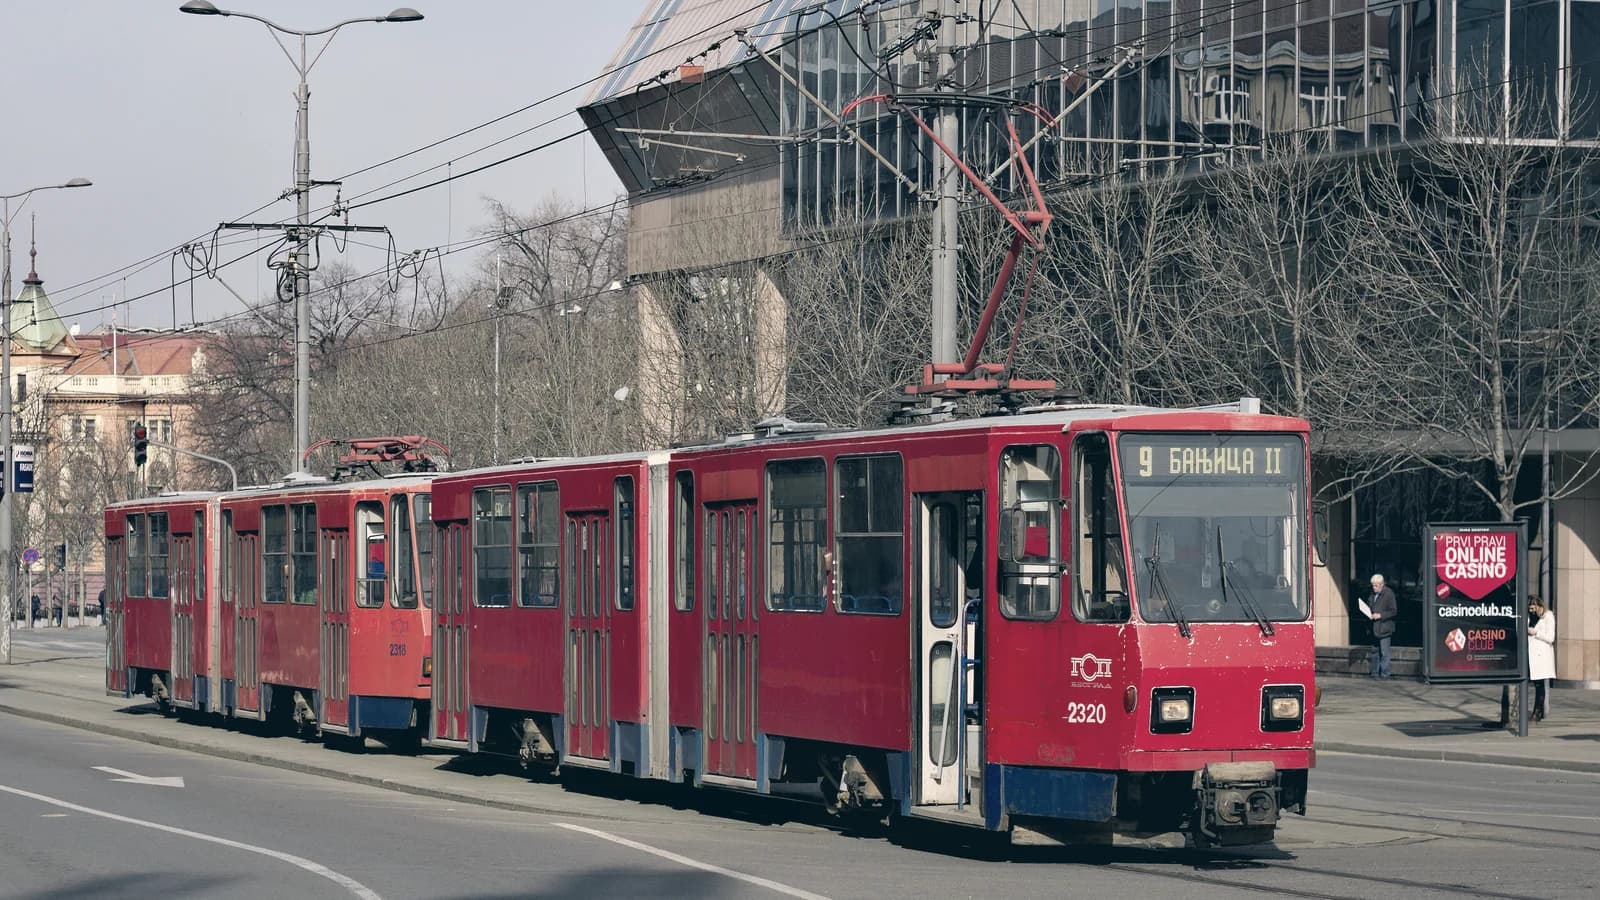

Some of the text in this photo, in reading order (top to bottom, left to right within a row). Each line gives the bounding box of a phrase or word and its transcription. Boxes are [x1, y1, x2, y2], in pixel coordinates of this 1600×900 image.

[1139, 446, 1153, 477] 9
[1169, 447, 1254, 474] БАЊИЦА
[1445, 535, 1471, 547] PRVI
[1473, 535, 1506, 547] PRAVI
[1445, 547, 1506, 562] ONLINE
[1445, 563, 1507, 579] CASINO
[1438, 602, 1513, 617] casinoclub.rs
[1467, 629, 1506, 641] CASINO
[1467, 640, 1495, 650] CLUB
[1067, 701, 1107, 724] 2320
